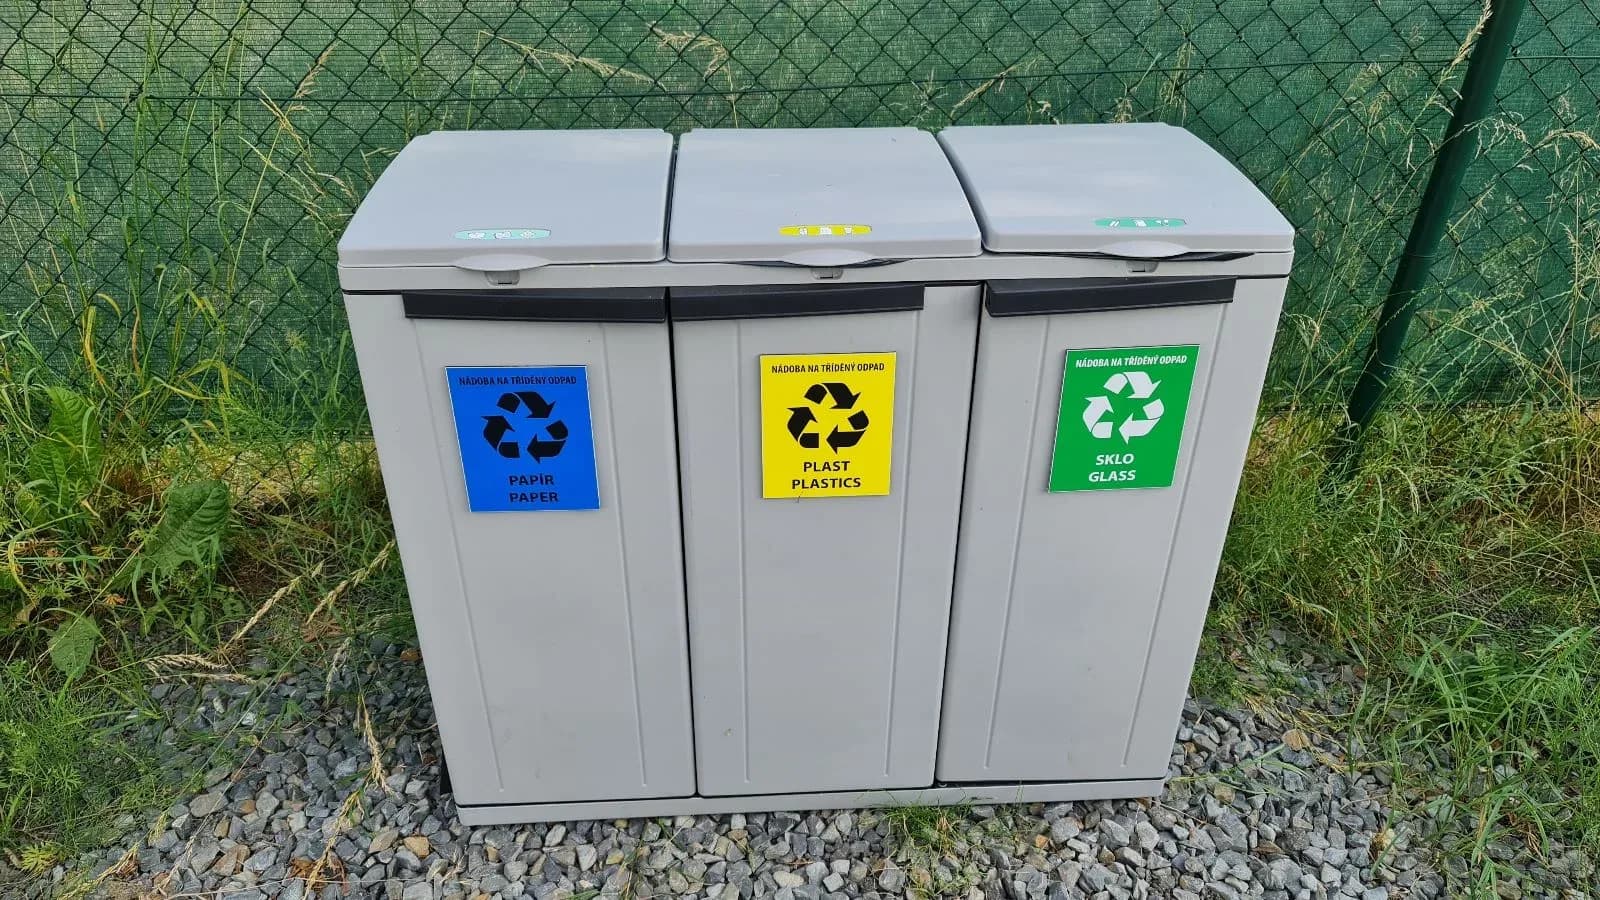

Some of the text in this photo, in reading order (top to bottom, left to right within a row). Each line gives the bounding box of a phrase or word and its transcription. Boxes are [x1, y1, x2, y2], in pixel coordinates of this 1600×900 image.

[1075, 354, 1188, 368] NÁDOBA NA TŘÍDĚNÝ ODPAD
[771, 362, 885, 374] NÁDOBA NA TŘÍDĚNÝ ODPAD
[497, 376, 509, 385] NA
[548, 375, 577, 385] ODPAD
[1095, 453, 1135, 466] SKLO
[803, 460, 851, 473] PLAST
[508, 471, 554, 486] PAPÍR
[1088, 470, 1137, 482] GLASS
[791, 477, 862, 490] PLASTICS
[508, 491, 559, 503] PAPER
